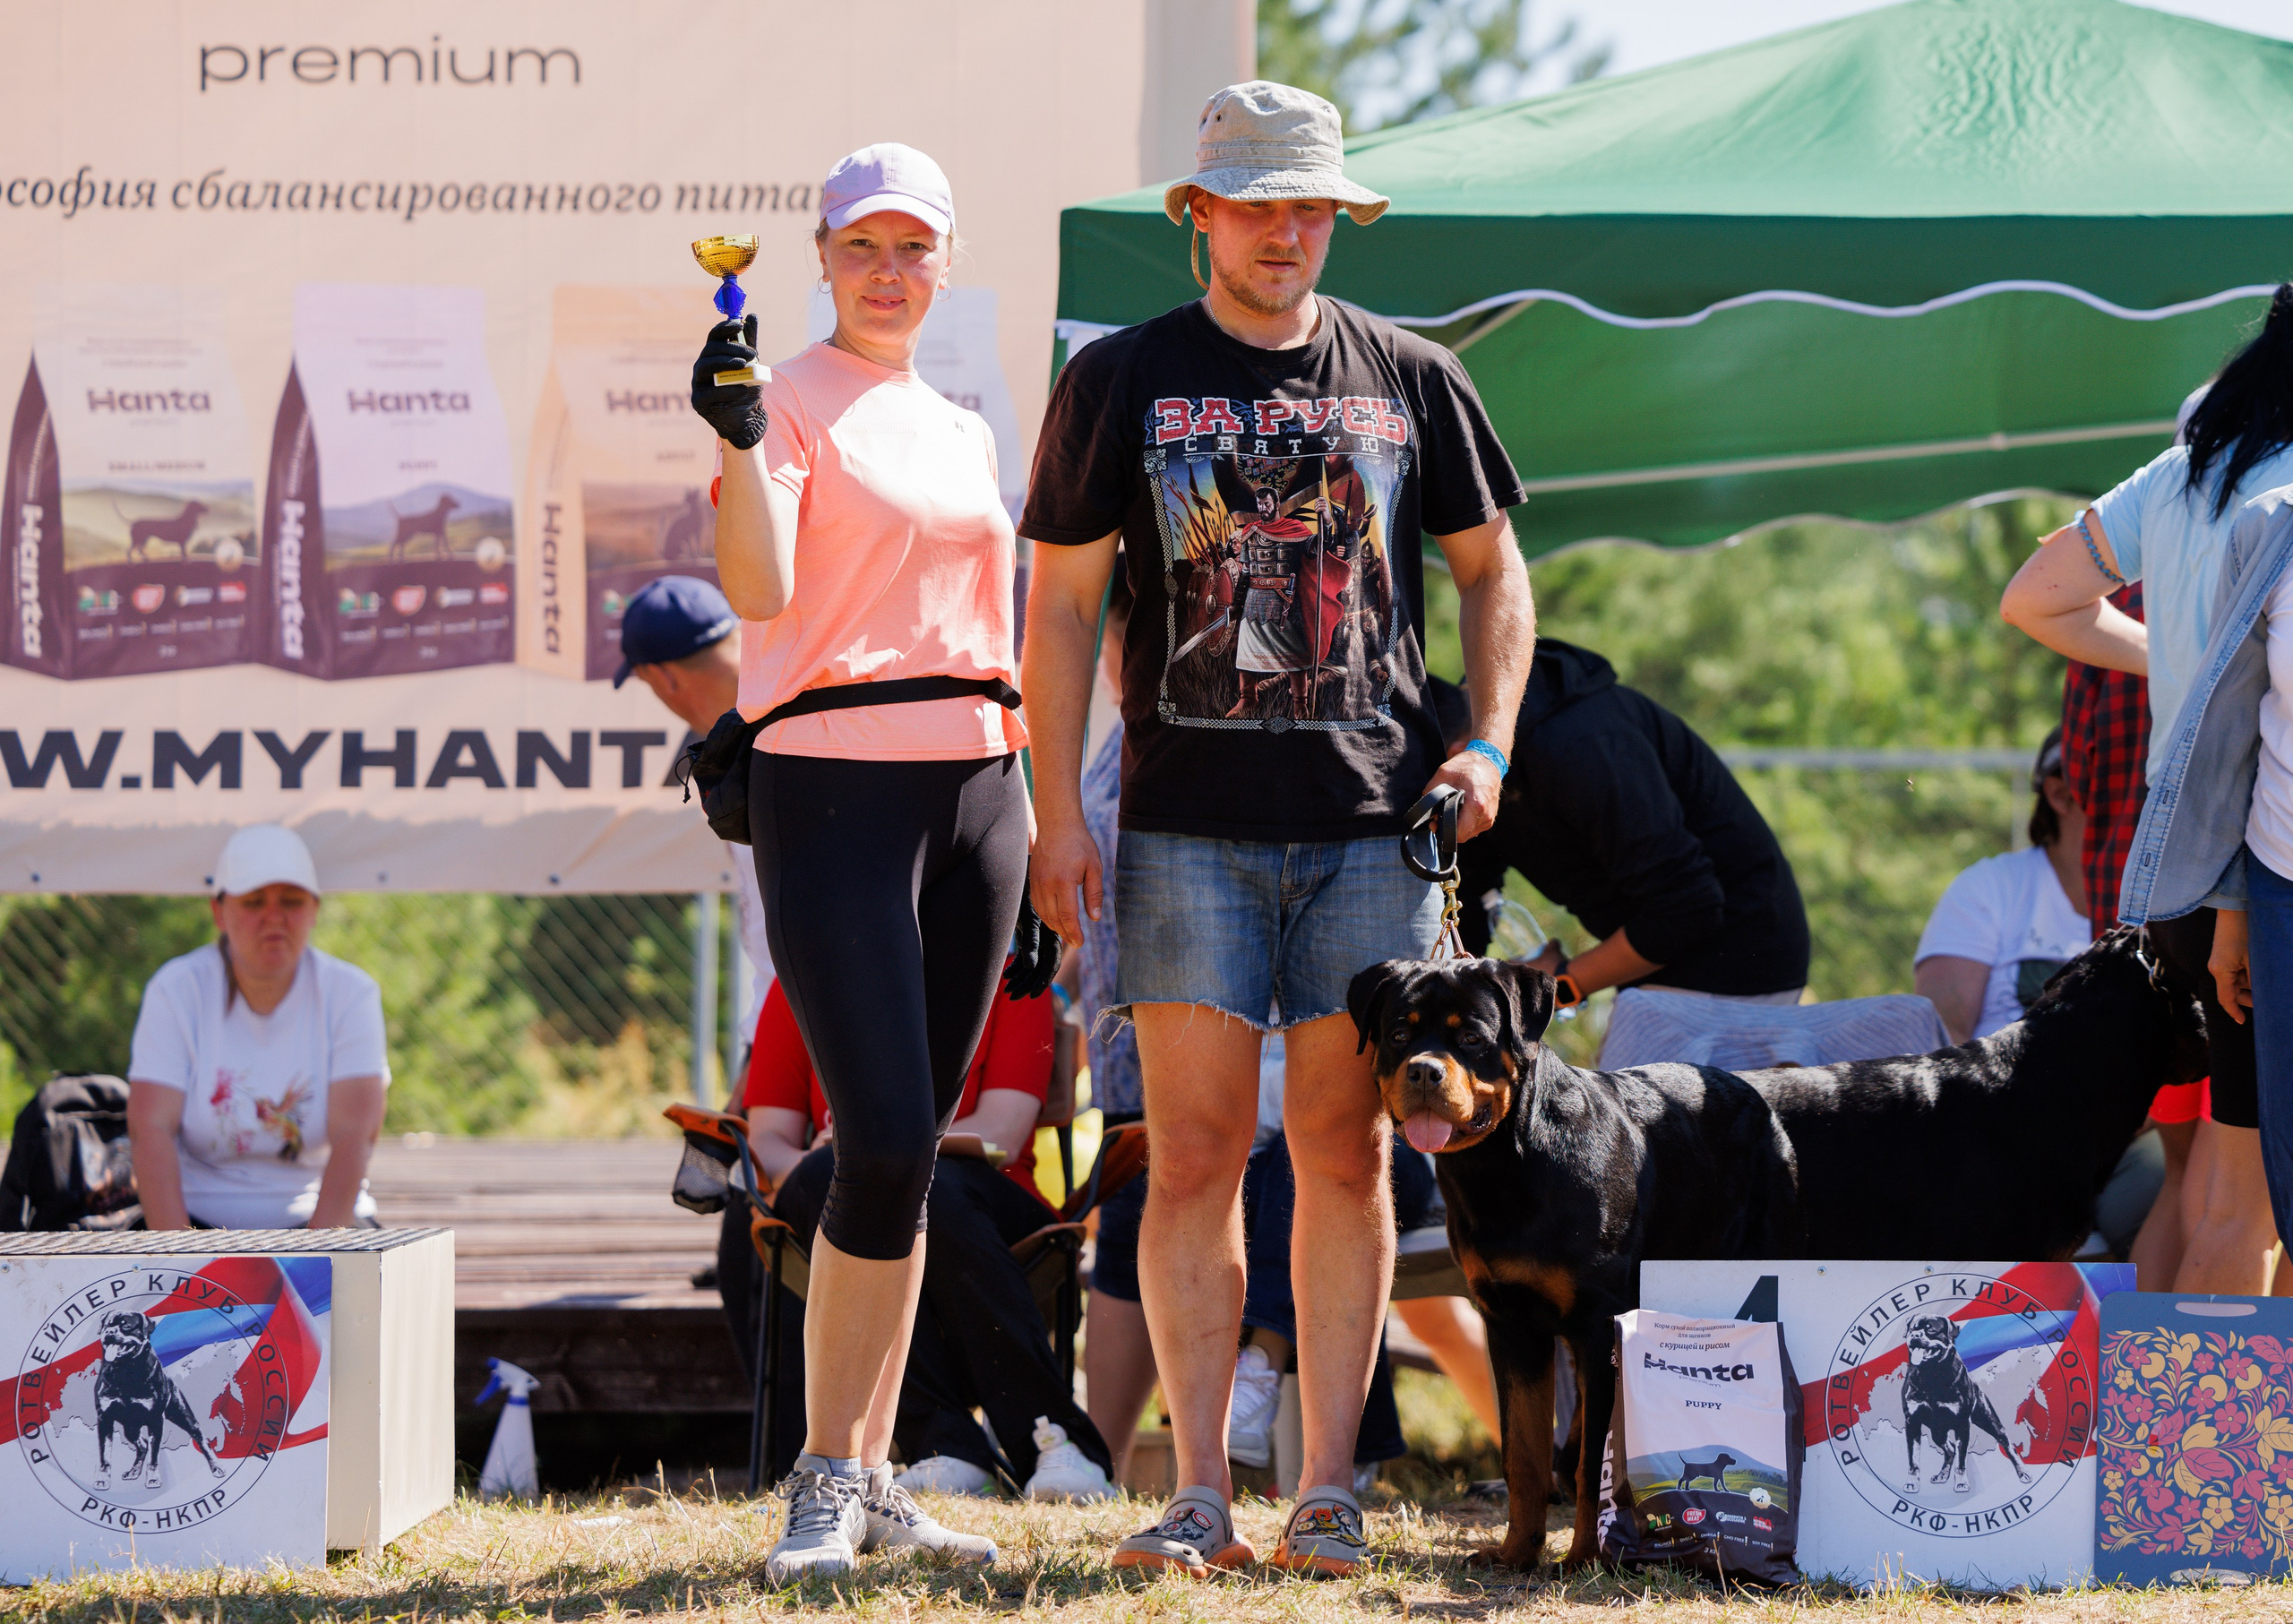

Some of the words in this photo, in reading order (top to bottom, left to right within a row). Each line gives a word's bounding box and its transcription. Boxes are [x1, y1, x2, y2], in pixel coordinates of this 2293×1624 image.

[199, 34, 583, 93] premium
[0, 165, 156, 218] софия
[172, 168, 661, 223] сбалансированного
[675, 182, 825, 212] пита
[86, 388, 211, 413] Hanta
[347, 388, 470, 413] Hanta
[605, 388, 691, 413] Han
[1155, 397, 1244, 446] ЗА
[1252, 397, 1409, 446] РУСЬ
[1184, 434, 1380, 454] СВЯТУЮ
[21, 503, 43, 658] Hanta
[279, 499, 305, 660] Hanta
[543, 502, 563, 655] Hanta
[1644, 1352, 1755, 1382] Hanta
[1664, 1342, 1698, 1351] курицей
[1705, 1342, 1730, 1351] рисом
[20, 1278, 127, 1465] РОТВЕЙЛЕР
[148, 1273, 239, 1315] КЛУБ
[244, 1321, 286, 1464] РОССИИ
[1828, 1282, 1931, 1466] РОТВЕЙЛЕР
[1952, 1277, 2041, 1321] КЛУБ
[2046, 1328, 2091, 1470] РОССИИ
[1685, 1399, 1722, 1410] PUPPY
[81, 1488, 228, 1531] РКФ-НКПР
[1891, 1493, 2034, 1534] РКФ-НКПР
